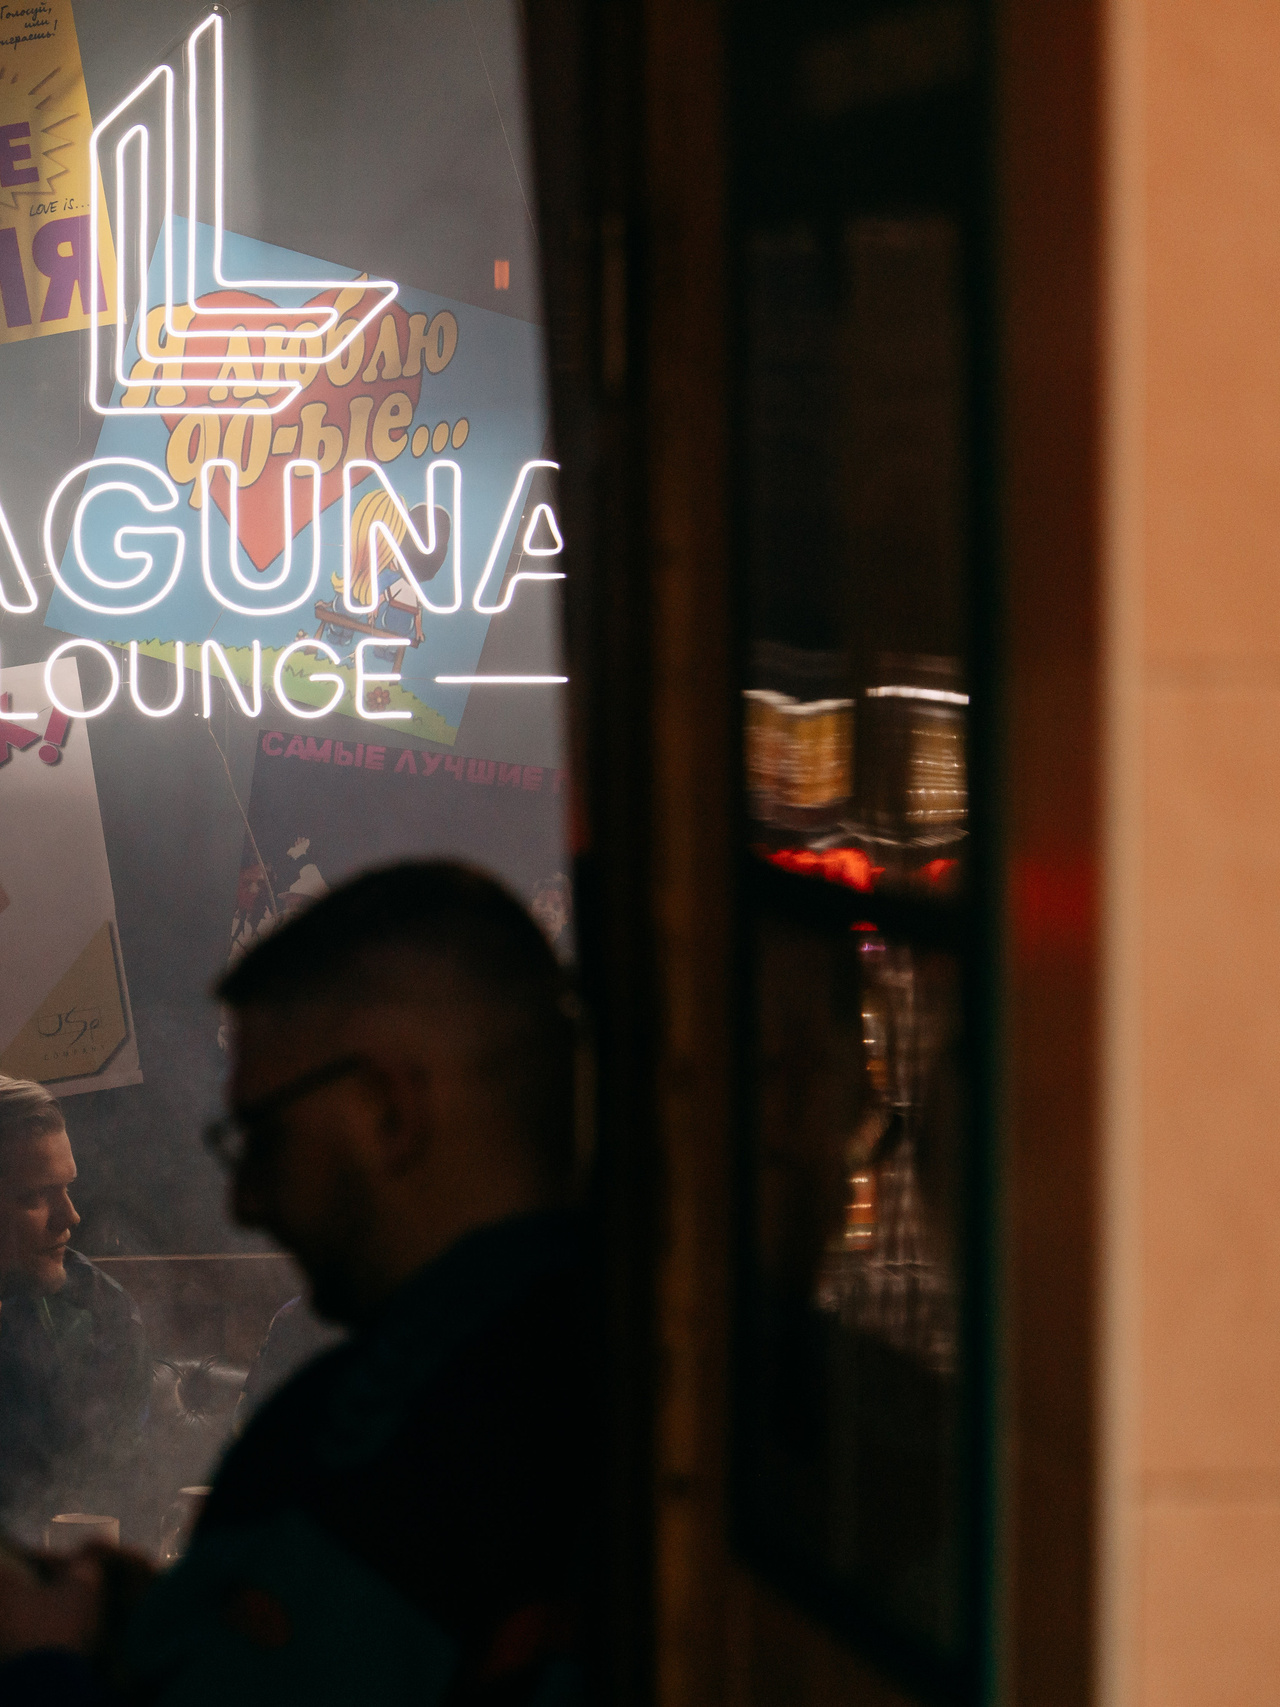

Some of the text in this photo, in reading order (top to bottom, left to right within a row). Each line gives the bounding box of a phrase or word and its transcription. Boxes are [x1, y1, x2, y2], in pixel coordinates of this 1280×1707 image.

[29, 200, 59, 217] LOVE
[261, 731, 386, 771] САМЫЕ
[393, 750, 544, 792] ЛУЧШИЕ
